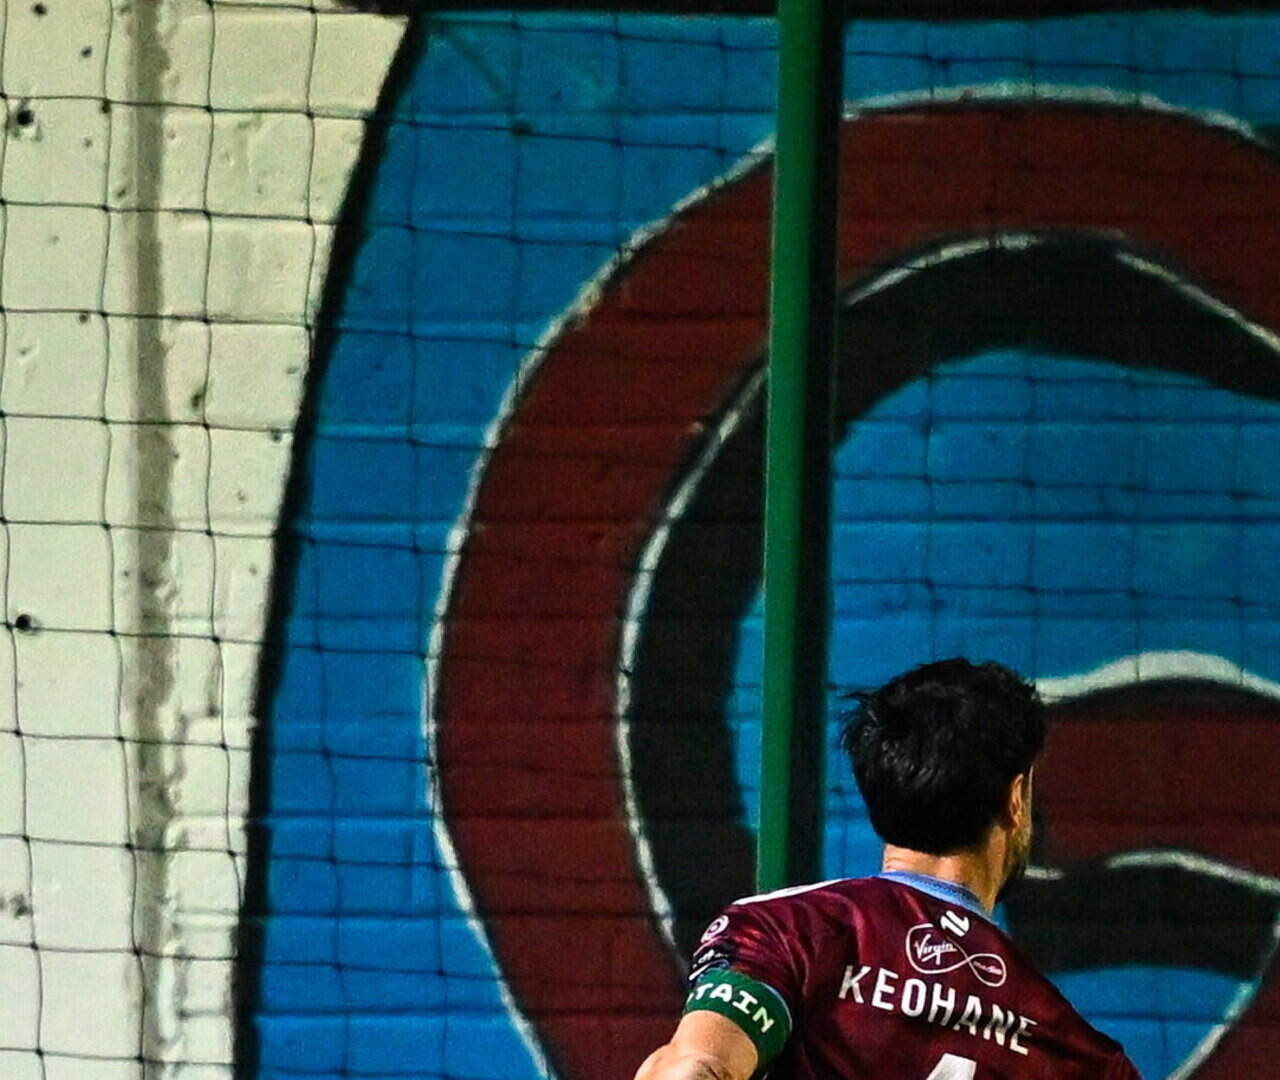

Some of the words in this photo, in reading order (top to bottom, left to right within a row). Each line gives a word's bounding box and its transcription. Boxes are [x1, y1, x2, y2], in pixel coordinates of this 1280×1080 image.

[913, 933, 958, 966] Virgin
[686, 983, 775, 1033] TAIN
[838, 964, 1038, 1056] KEOHANE
